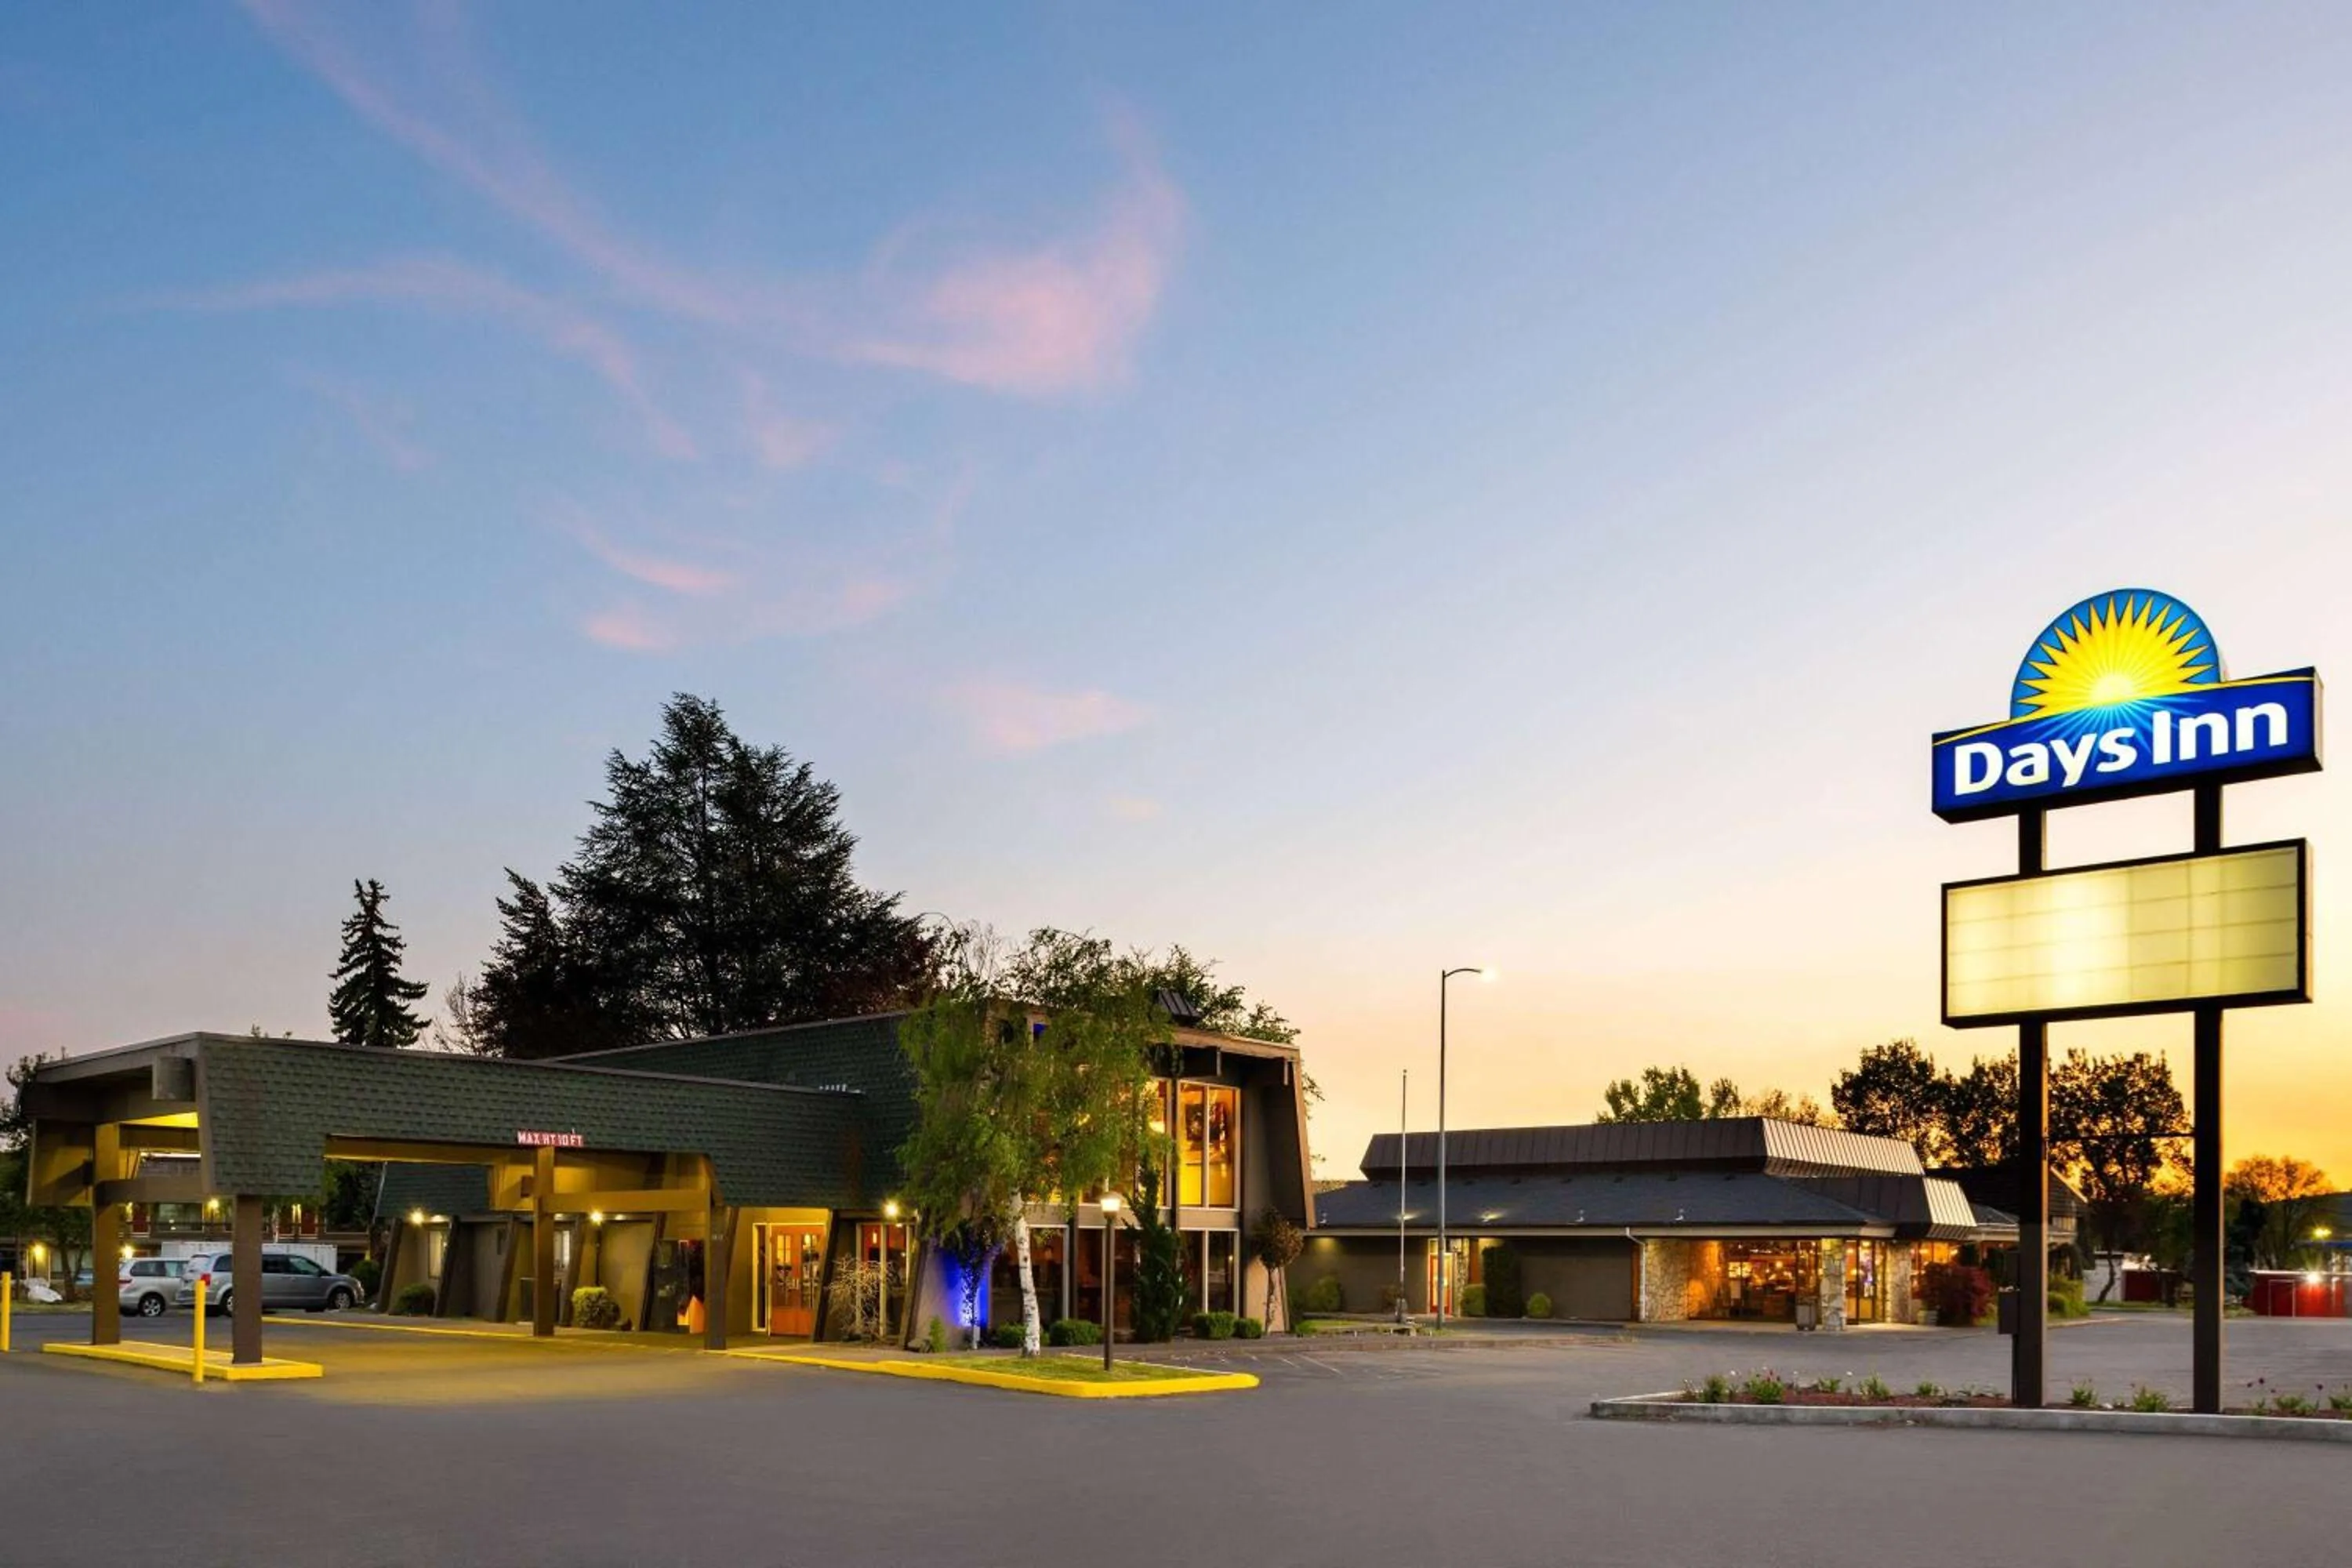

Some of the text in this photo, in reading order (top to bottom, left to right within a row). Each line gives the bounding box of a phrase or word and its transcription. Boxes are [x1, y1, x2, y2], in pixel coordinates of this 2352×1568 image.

[1955, 702, 2288, 796] Days Inn
[517, 1131, 539, 1145] MAX
[543, 1133, 556, 1145] HT
[570, 1134, 583, 1147] FT
